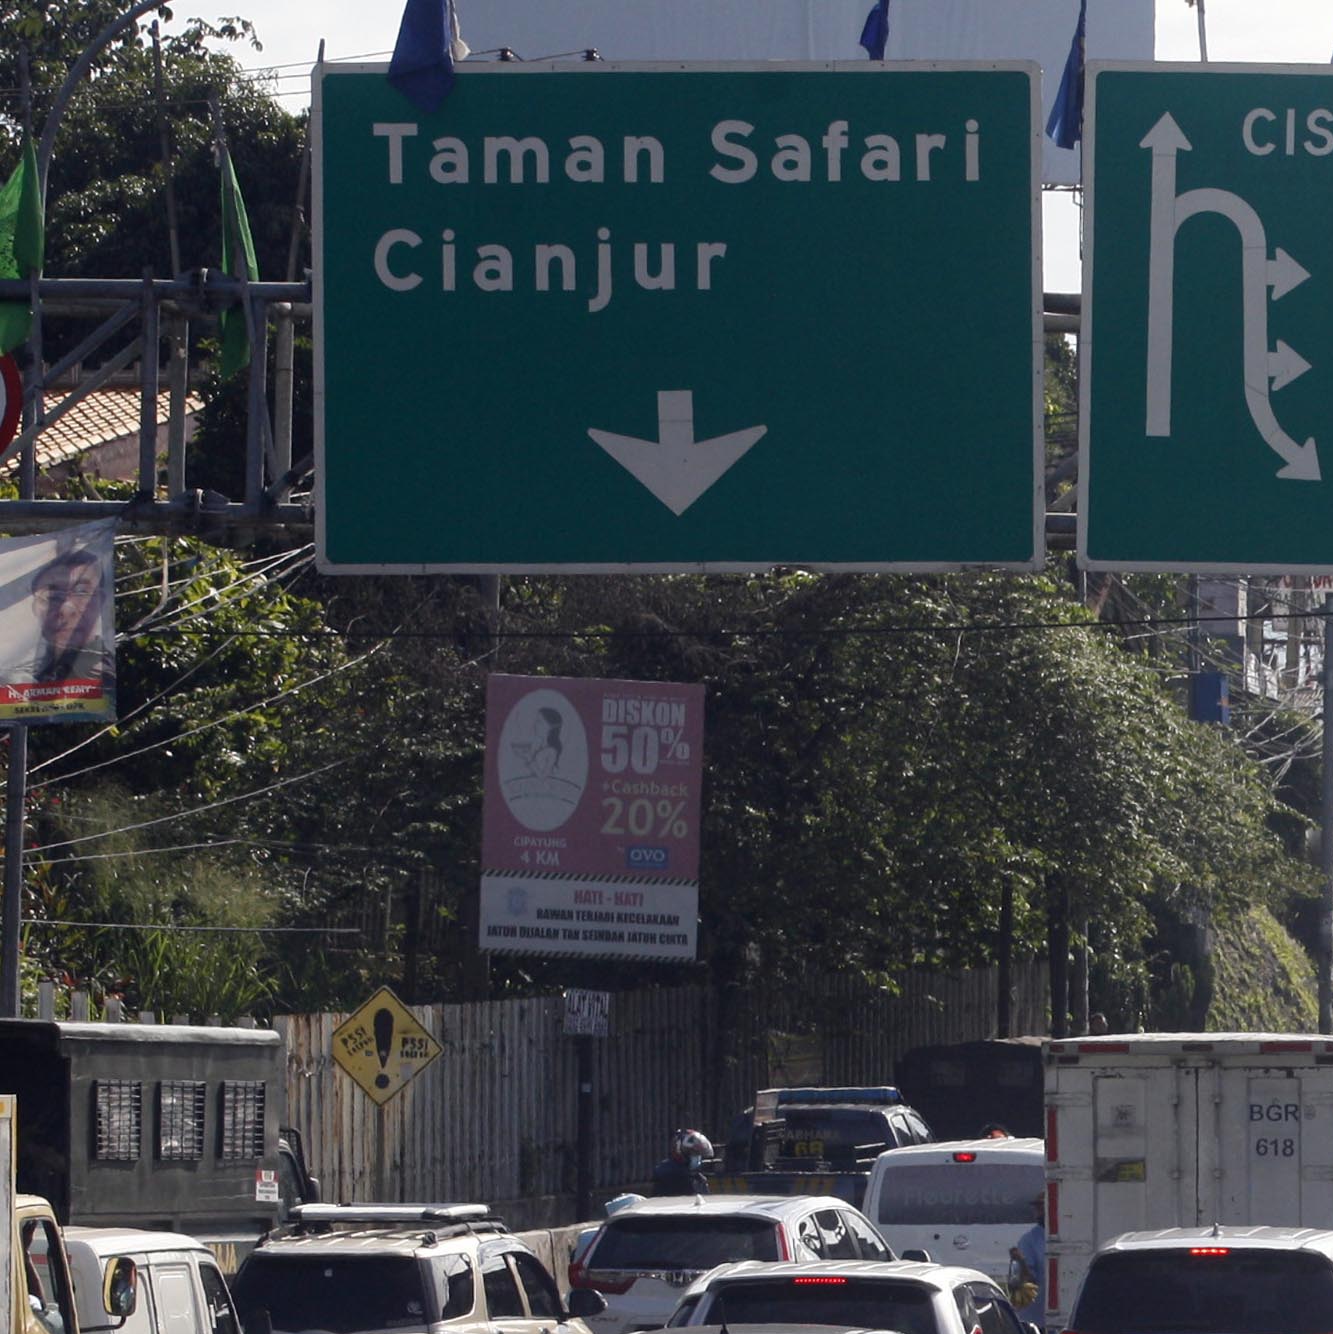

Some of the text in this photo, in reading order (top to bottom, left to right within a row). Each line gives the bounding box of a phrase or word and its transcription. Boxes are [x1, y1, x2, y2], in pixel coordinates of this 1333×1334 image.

[373, 119, 981, 184] Taman Safari
[374, 227, 727, 312] Cianjur
[602, 698, 686, 728] DISKON
[601, 725, 690, 774] 50%
[602, 780, 688, 797] +Cashback
[601, 797, 688, 838] 20%
[513, 837, 567, 849] CIPAYUNG
[521, 851, 560, 866] 4 KM
[630, 849, 665, 862] OVO
[574, 890, 604, 906] HATI
[614, 891, 644, 907] HATI
[536, 908, 573, 921] RAWAN
[616, 912, 680, 926] KECELAKAAN
[1249, 1103, 1299, 1122] BGR
[1256, 1138, 1294, 1157] 618
